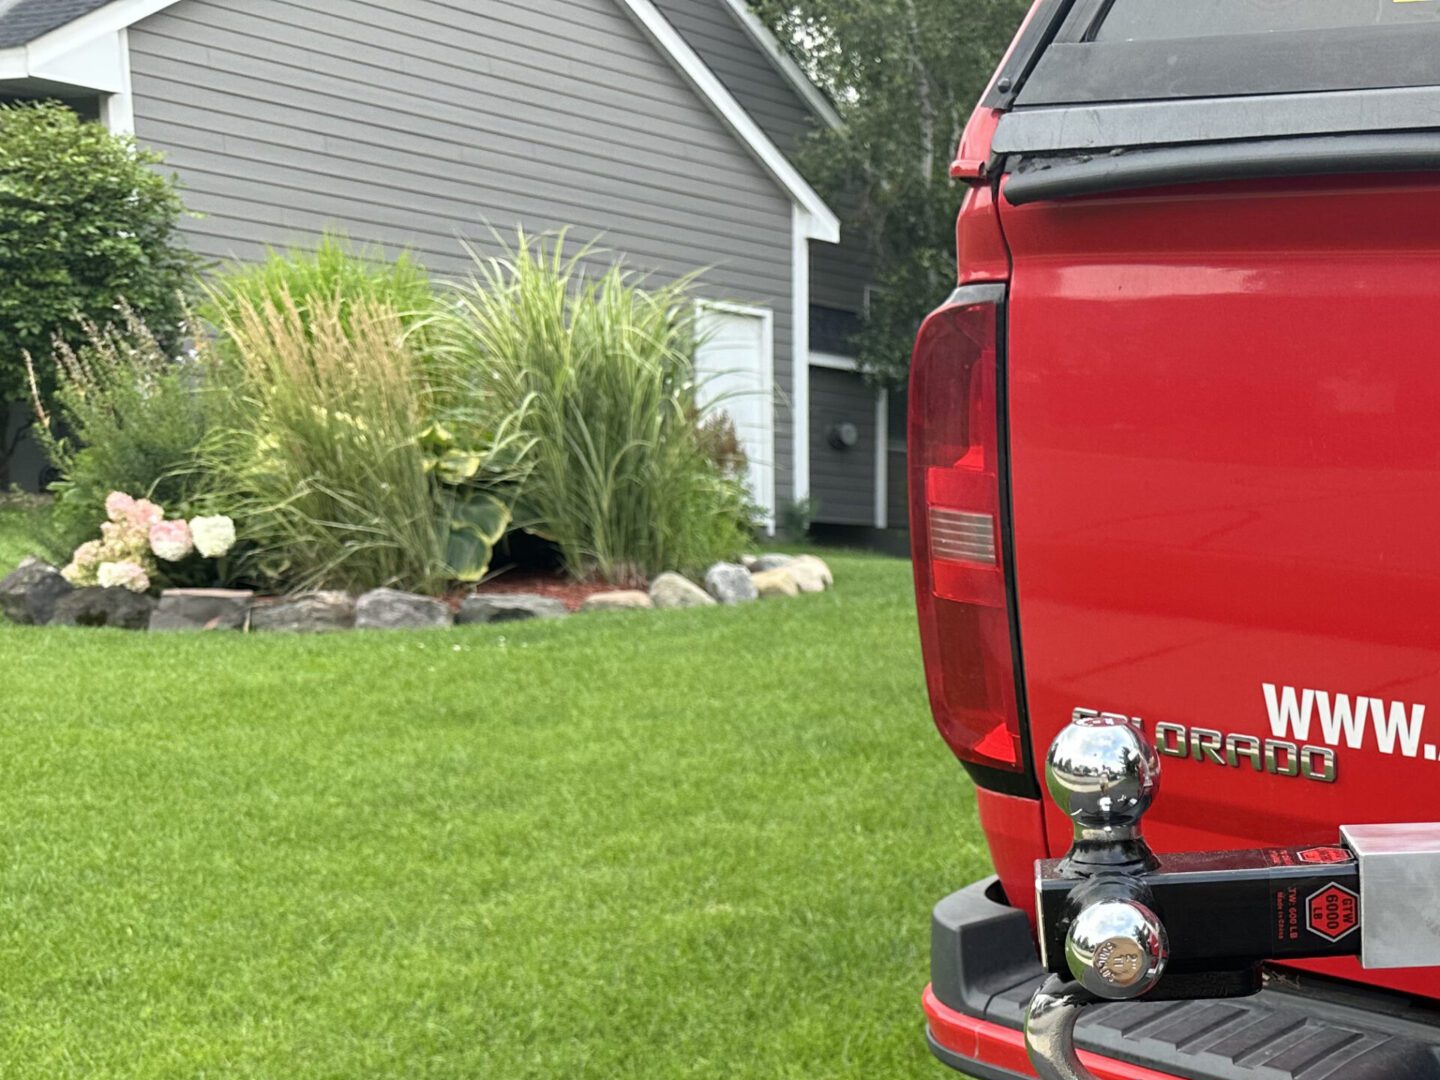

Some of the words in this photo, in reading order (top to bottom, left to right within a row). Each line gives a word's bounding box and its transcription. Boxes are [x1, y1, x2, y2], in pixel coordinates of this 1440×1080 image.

[1313, 906, 1323, 920] LB
[1326, 894, 1340, 930] 6000
[1341, 898, 1354, 924] GTW
